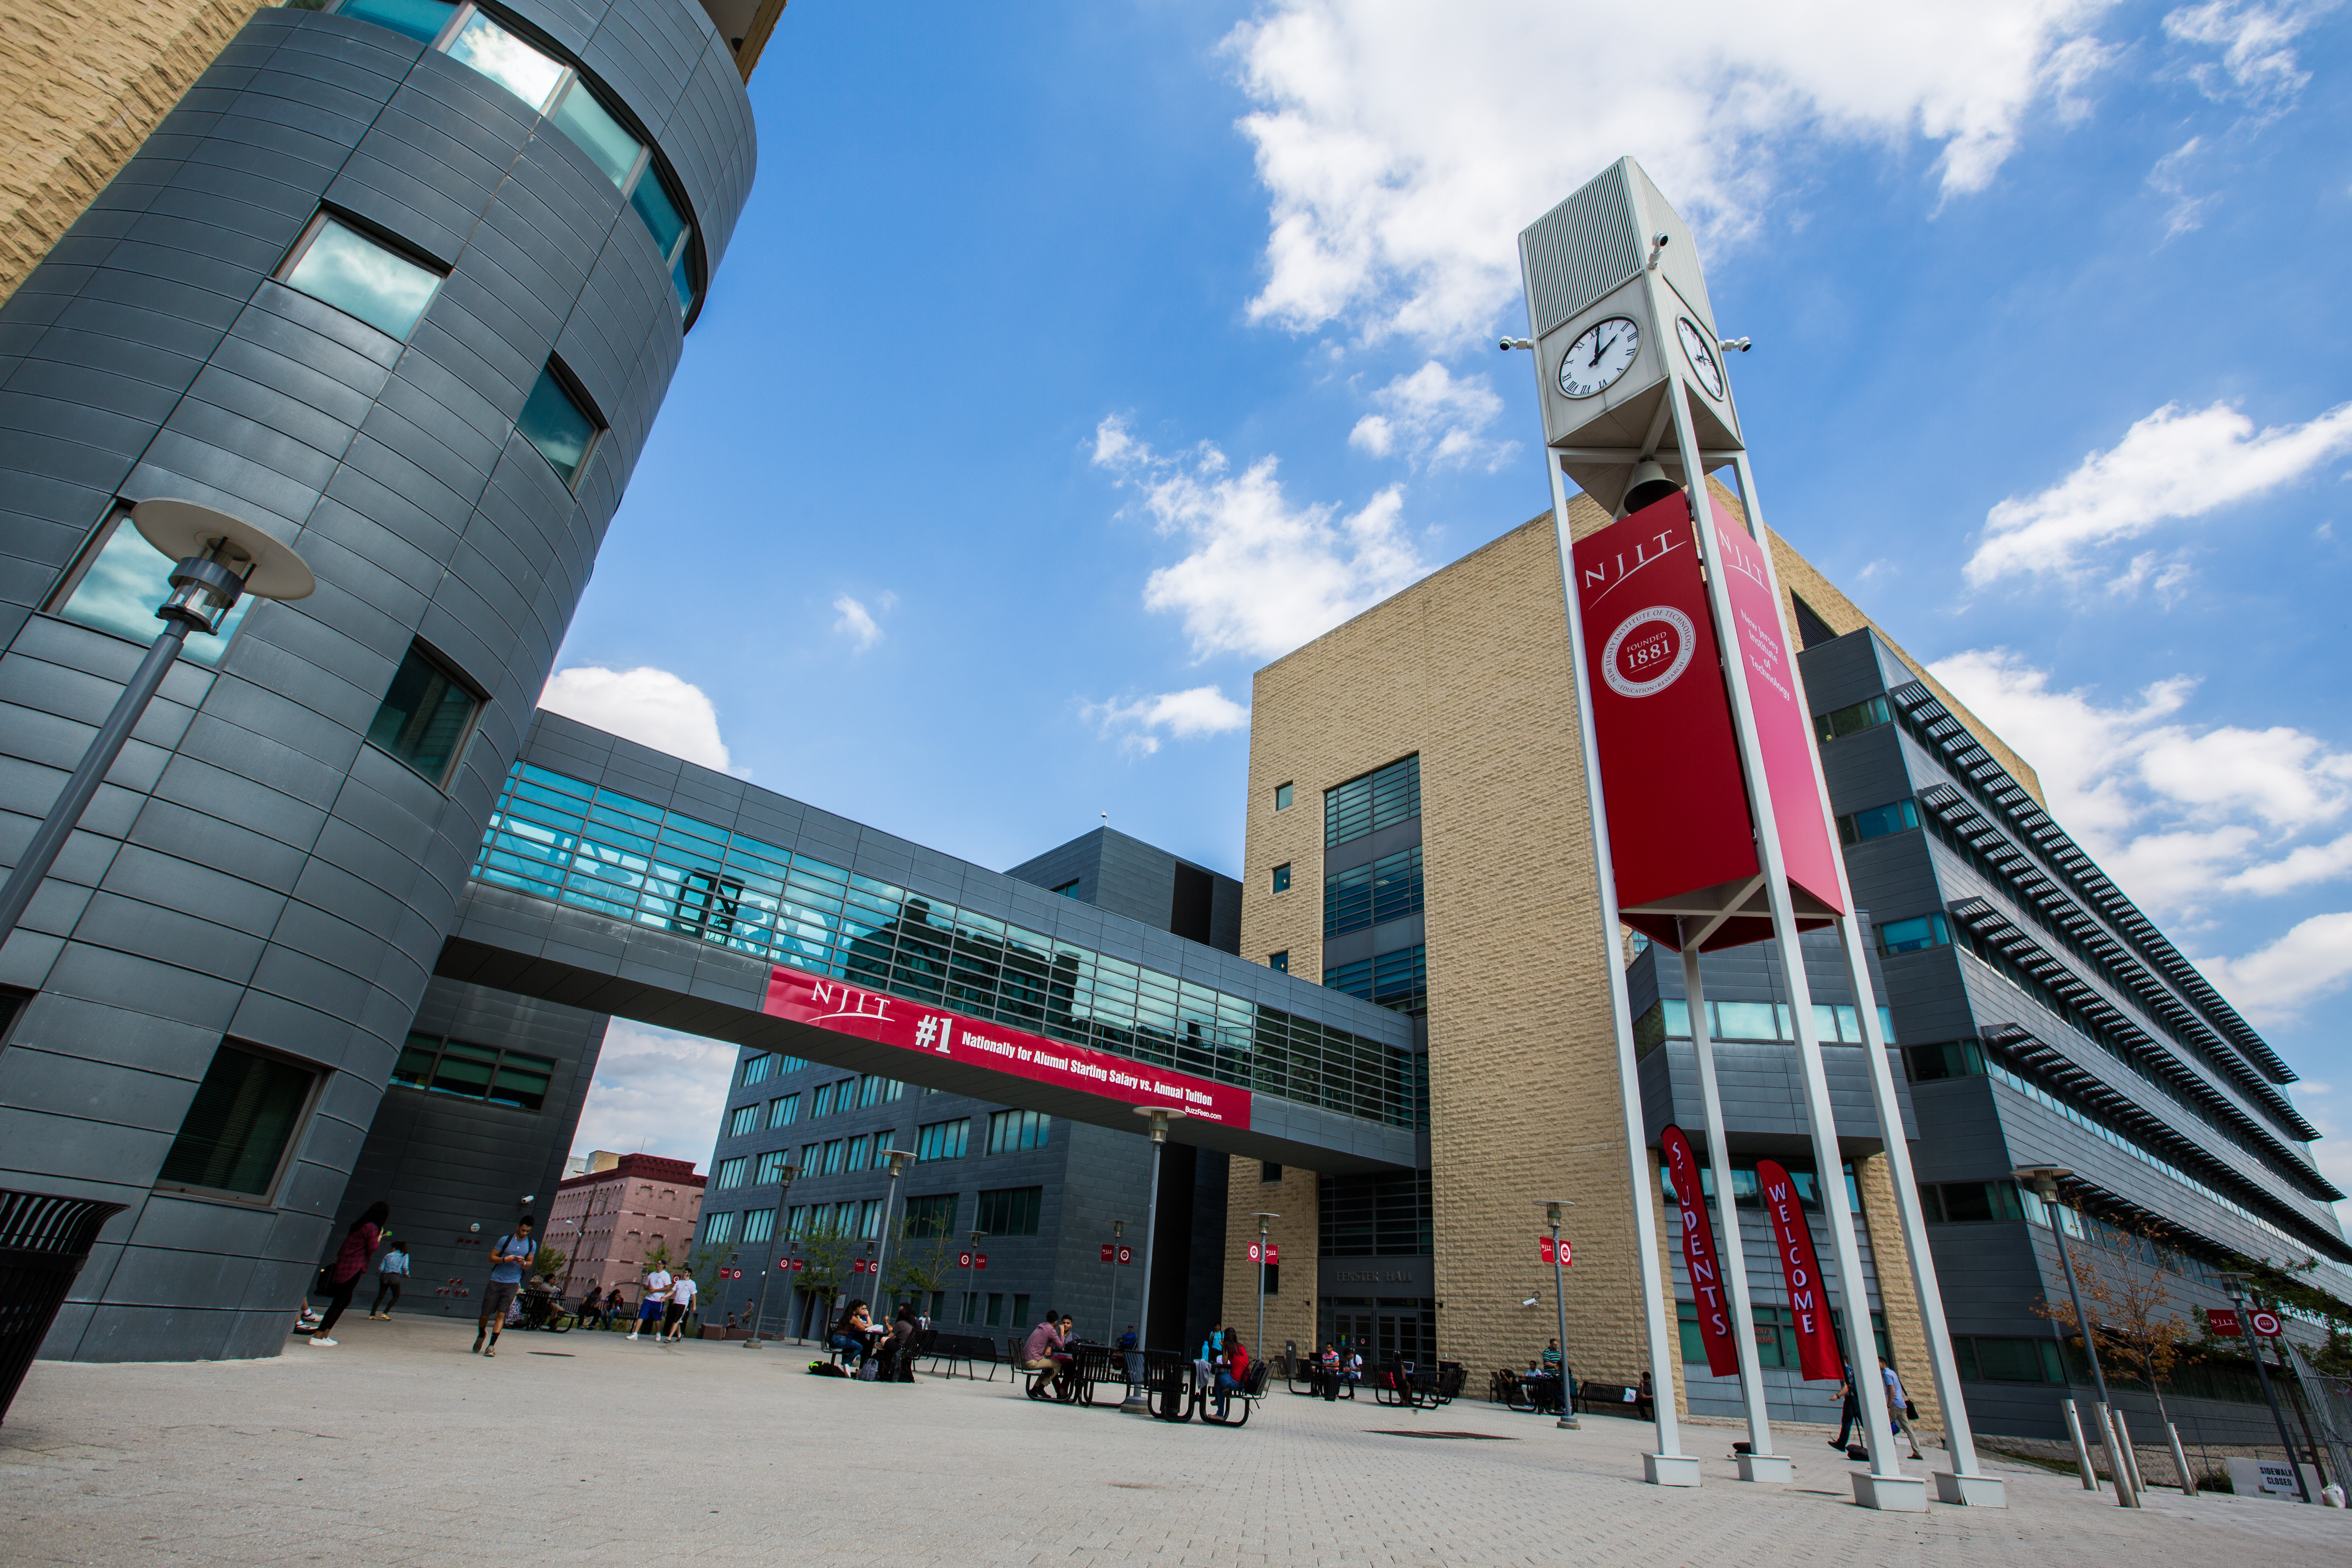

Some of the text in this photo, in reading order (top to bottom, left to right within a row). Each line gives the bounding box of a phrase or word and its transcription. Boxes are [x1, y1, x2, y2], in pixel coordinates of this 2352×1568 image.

[1620, 322, 1630, 332] II
[1627, 331, 1637, 343] III
[1574, 341, 1585, 351] XI
[1566, 381, 1579, 393] VIII
[1580, 385, 1591, 394] VII
[1585, 529, 1673, 588] NJIT
[1719, 527, 1762, 586] NJIT
[1614, 611, 1650, 640] INSTITUTE
[1665, 610, 1691, 651] TECHNOLOGY
[1741, 609, 1778, 654] New Jersey
[1606, 642, 1616, 666] JERSEY
[1627, 631, 1667, 653] FOUNDED
[1628, 639, 1671, 669] 1881
[1748, 629, 1778, 664] Institute
[1607, 668, 1617, 683] NEW
[1619, 662, 1684, 693] EDUCATION RESEARCH
[1749, 655, 1789, 701] Technology
[1764, 659, 1771, 670] of
[811, 981, 890, 1019] NJIT
[915, 1014, 1212, 1106] #1 Nationally for Alumni Starting Salary vs. Annual Tuition
[1673, 1142, 1726, 1335] STUDENTS
[1768, 1182, 1813, 1334] WELCOME
[1336, 1271, 1413, 1282] FENSTER HALL
[2259, 1467, 2294, 1477] SIDEWALK
[2266, 1477, 2292, 1486] CLOSED
